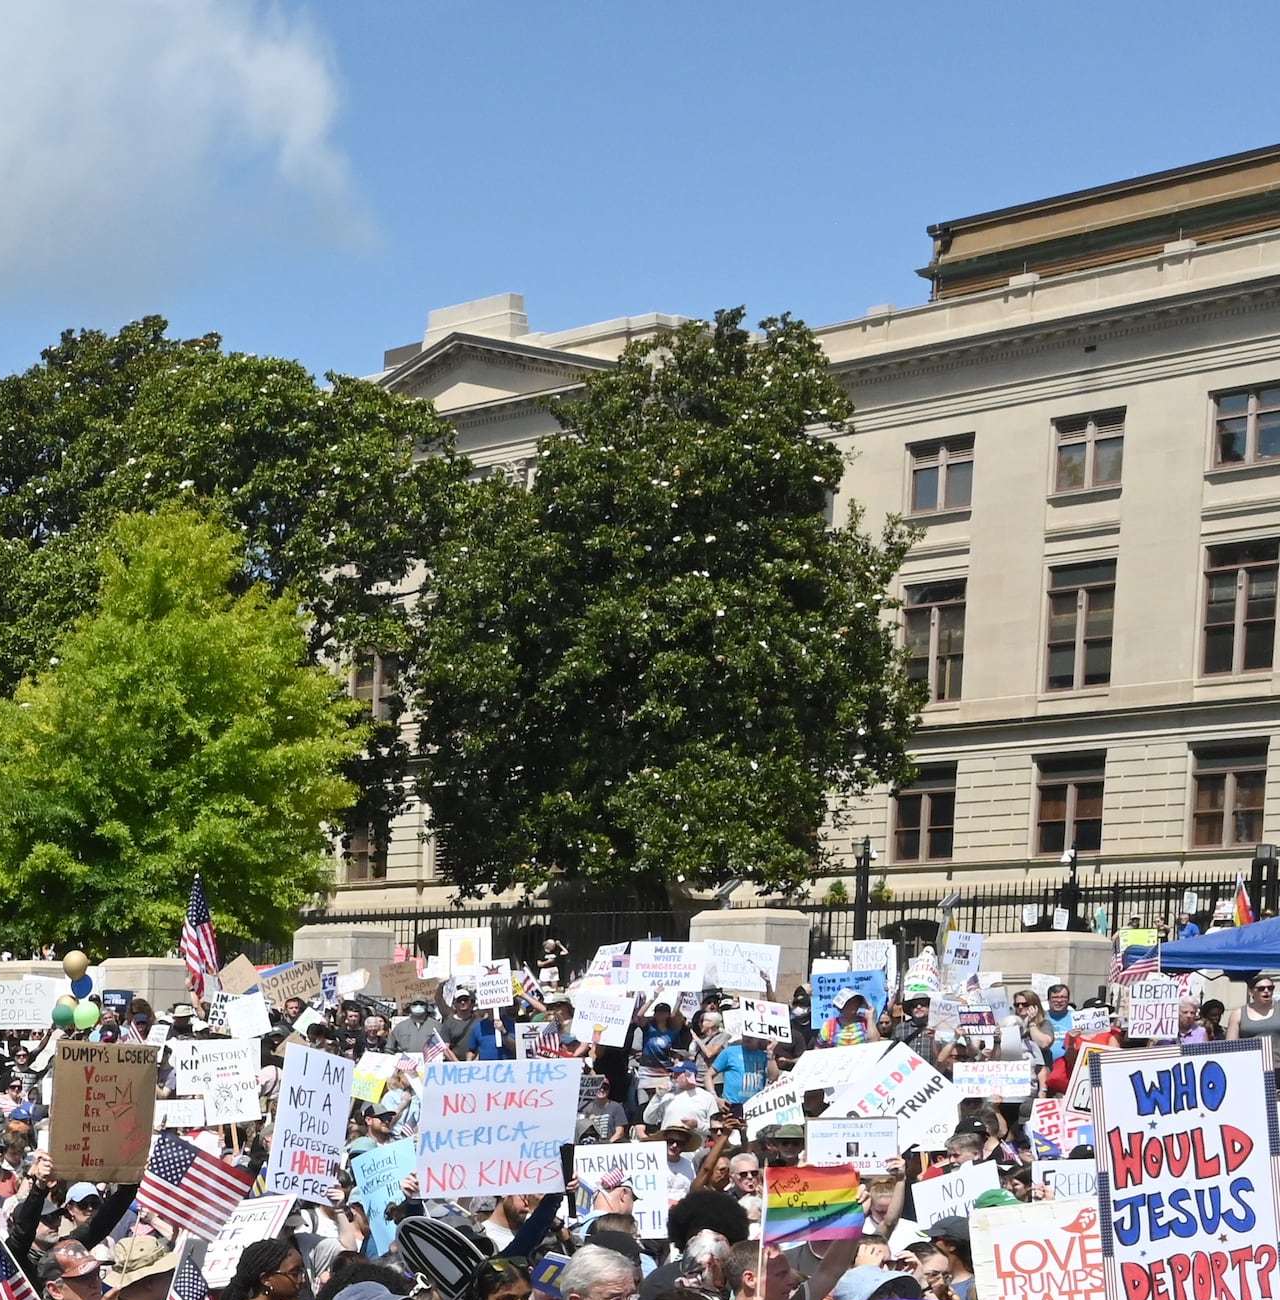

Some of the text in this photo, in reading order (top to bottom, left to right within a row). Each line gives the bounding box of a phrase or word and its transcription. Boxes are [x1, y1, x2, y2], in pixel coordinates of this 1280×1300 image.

[653, 954, 681, 962] WHITE
[654, 946, 684, 954] MAKE
[260, 958, 315, 993] NO HUMAN
[479, 978, 509, 988] IMPEACH
[642, 971, 690, 979] CHRISTIAN
[650, 979, 680, 987] AGAIN
[479, 986, 509, 996] CONVICT
[480, 996, 511, 1006] REMOVE
[1131, 983, 1180, 1000] LIBERTY
[1073, 1010, 1107, 1022] WE ARE
[1131, 1003, 1179, 1021] JUSTICE
[744, 1019, 789, 1039] KING
[963, 1025, 996, 1035] TRUMP
[1131, 1023, 1152, 1037] FOR
[117, 1049, 156, 1065] LOSERS
[201, 1048, 249, 1064] HISTORY
[322, 1059, 345, 1093] AM
[424, 1062, 568, 1087] AMERICA HAS
[857, 1056, 923, 1115] FREEDOM
[896, 1075, 944, 1120] TRUMP
[1130, 1059, 1227, 1118] WHO
[290, 1086, 332, 1116] NOT A
[442, 1089, 555, 1116] NO KINGS
[299, 1111, 329, 1136] PAID
[283, 1129, 340, 1156] PROTESTER
[420, 1121, 540, 1156] AMERICA
[291, 1150, 326, 1175] HATE
[361, 1151, 397, 1175] Federal
[1109, 1124, 1254, 1190] WOULD
[274, 1172, 299, 1190] FOR
[425, 1158, 563, 1192] NO KINGS
[942, 1178, 965, 1201] NO
[1113, 1177, 1256, 1247] JESUS
[994, 1234, 1100, 1280] LOVE
[1002, 1267, 1106, 1297] TRUMPS
